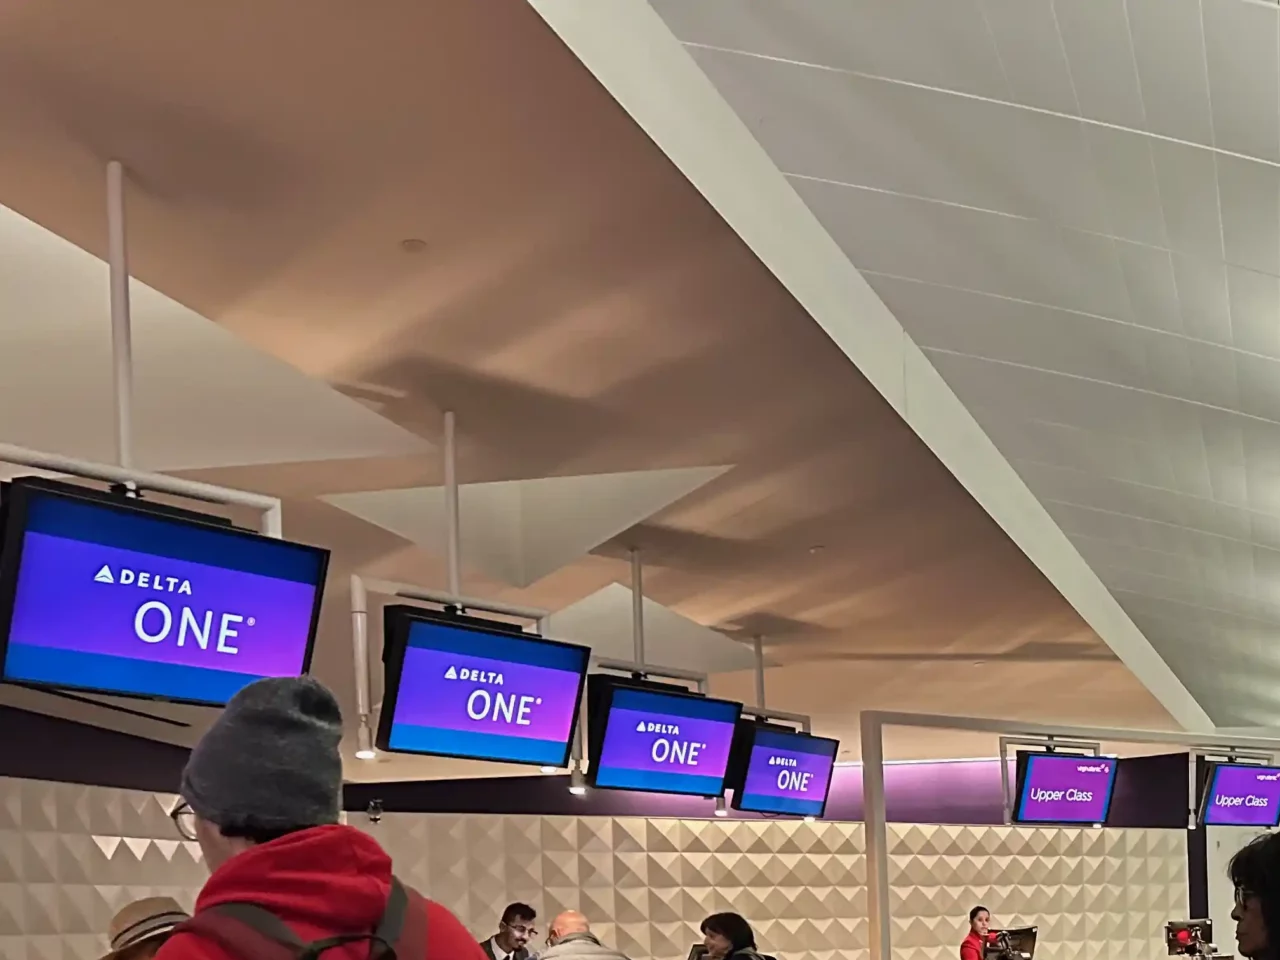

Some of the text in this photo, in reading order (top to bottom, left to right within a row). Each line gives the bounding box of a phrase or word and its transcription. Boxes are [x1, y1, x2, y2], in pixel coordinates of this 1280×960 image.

[120, 568, 192, 595] DELTA
[459, 668, 504, 685] DELTA
[647, 722, 680, 735] DELTA
[775, 756, 797, 767] DELTA
[1030, 787, 1093, 803] Upper Class
[1215, 794, 1269, 808] Upper Class
